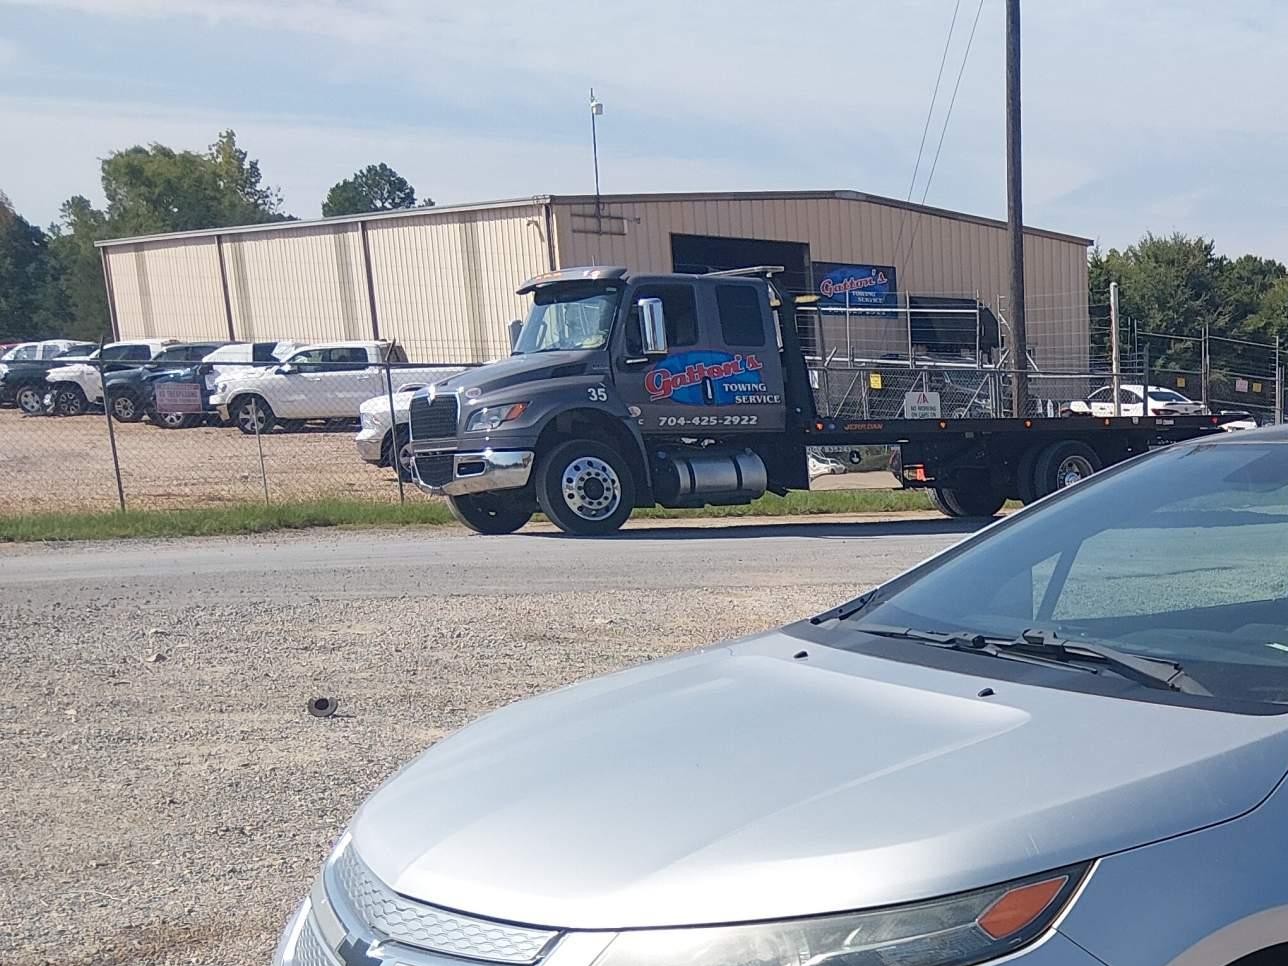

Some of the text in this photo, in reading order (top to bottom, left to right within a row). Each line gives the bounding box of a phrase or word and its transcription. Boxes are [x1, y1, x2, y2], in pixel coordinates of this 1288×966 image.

[820, 268, 888, 298] Gatton's
[645, 354, 763, 401] Gatton's
[723, 383, 767, 392] TOWING
[587, 387, 608, 401] 35
[735, 394, 781, 404] SERVICE
[659, 416, 758, 426] 704-425-2922
